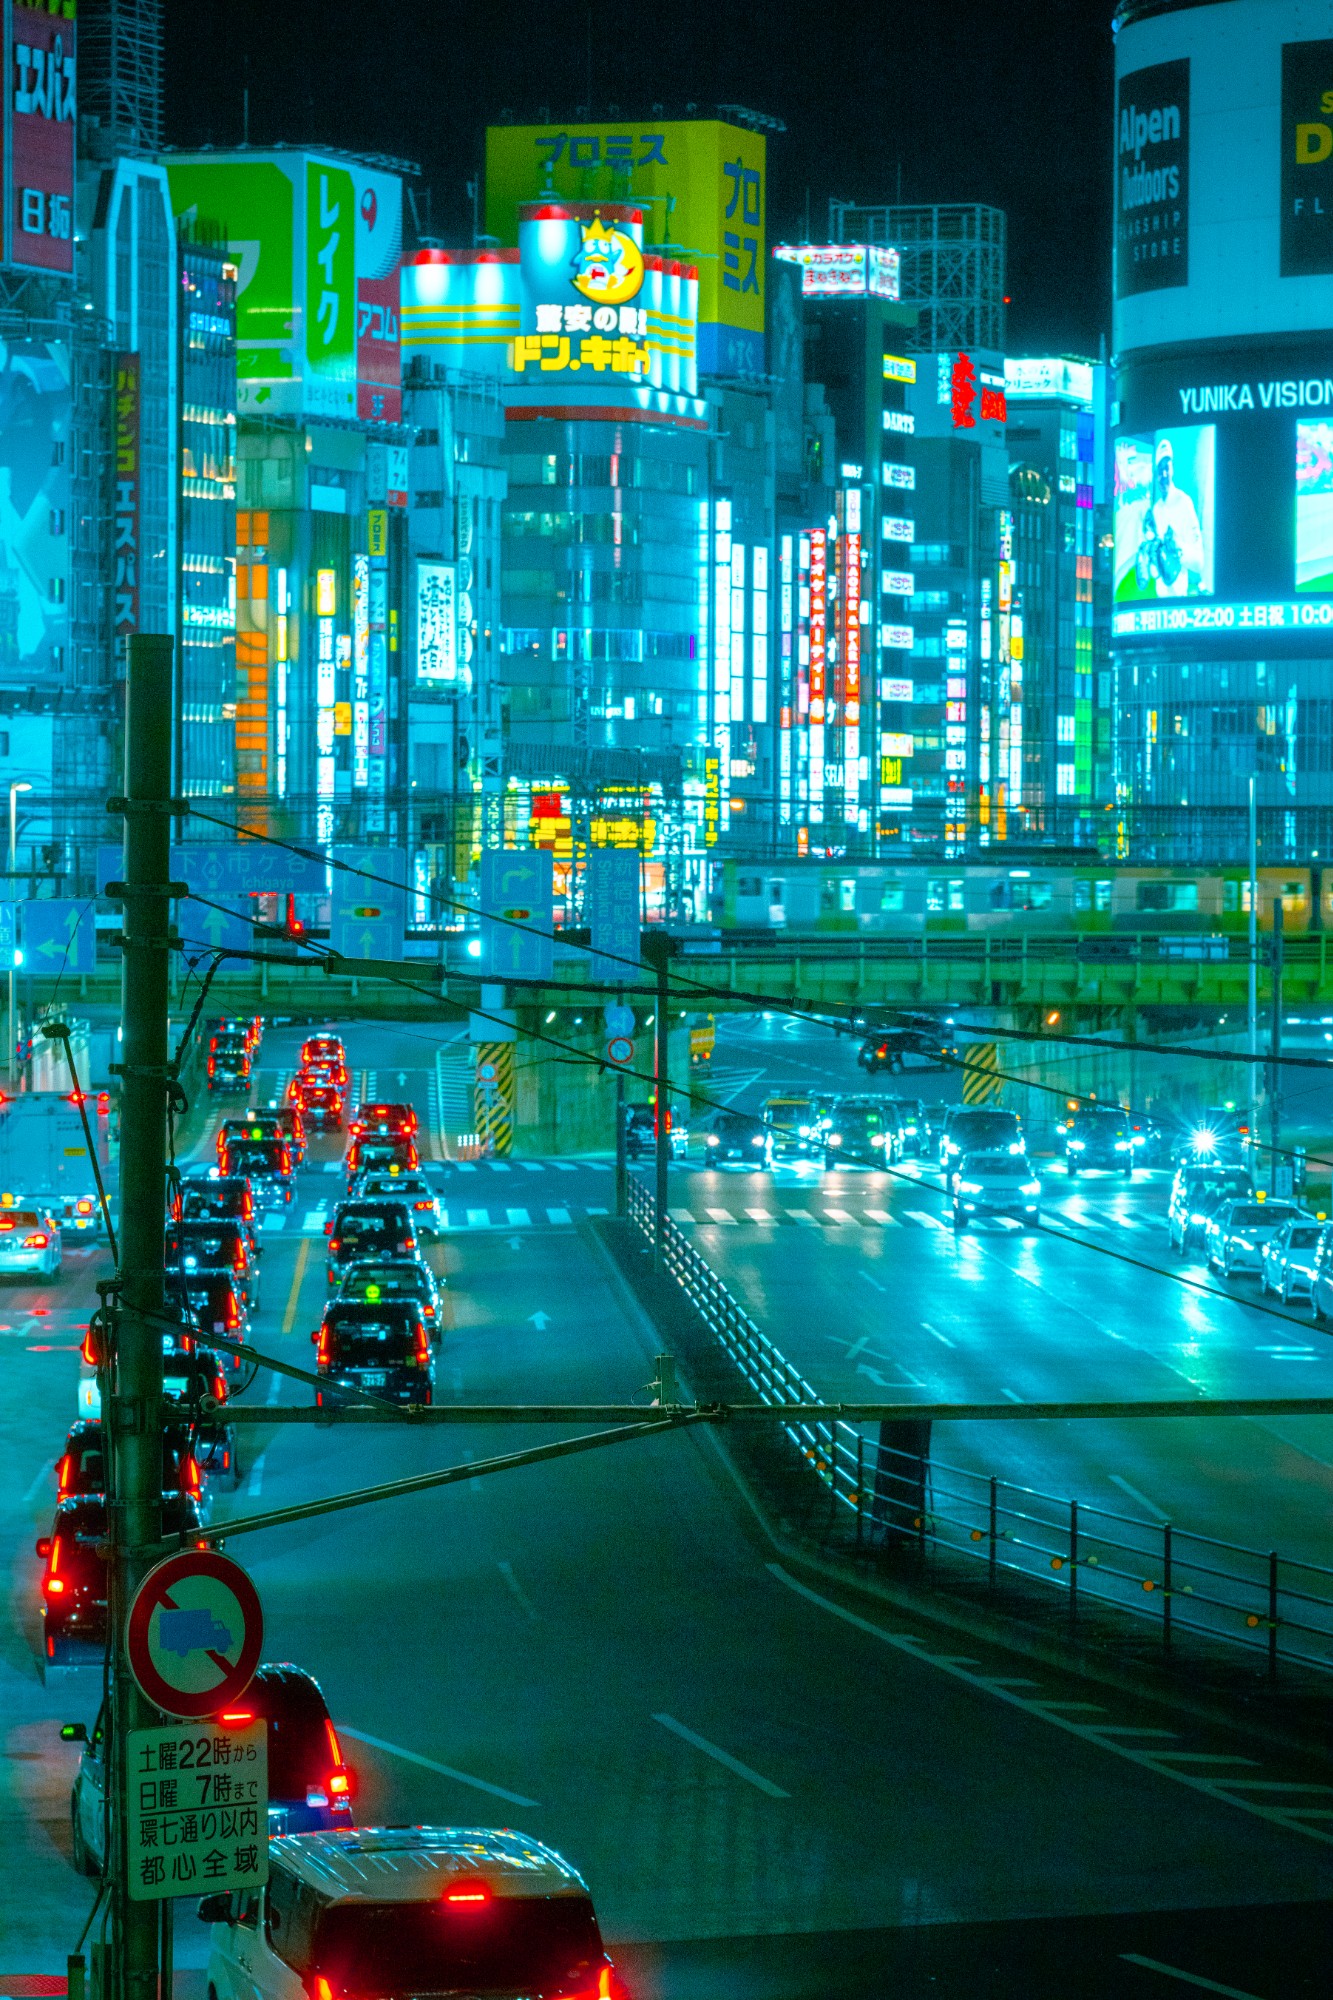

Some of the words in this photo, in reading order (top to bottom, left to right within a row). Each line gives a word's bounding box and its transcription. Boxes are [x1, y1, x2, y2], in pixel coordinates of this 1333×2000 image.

[15, 34, 76, 122] エスパス
[535, 133, 668, 166] プロミス
[1119, 103, 1180, 160] Alpen
[1122, 160, 1179, 210] Outdoors
[22, 187, 72, 240] 日拓
[316, 174, 339, 345] レイク
[811, 253, 854, 264] カラオケ
[1133, 238, 1180, 262] STORE
[358, 302, 398, 342] アコム
[1004, 378, 1052, 390] クリニック
[1179, 384, 1254, 413] YUNIKA
[116, 369, 136, 472] パチンコ
[883, 410, 914, 435] DARTS
[1238, 605, 1284, 627] 土日祝
[242, 876, 295, 891] Ichigaya
[596, 859, 613, 917] Shinjuku
[613, 857, 634, 972] 新宿駅東口
[138, 1736, 257, 1773] 土曜22時から
[140, 1779, 178, 1810] 日曜
[195, 1773, 258, 1805] 7時まで
[139, 1807, 258, 1848] 環七通り以内
[139, 1844, 259, 1885] 都心全域
